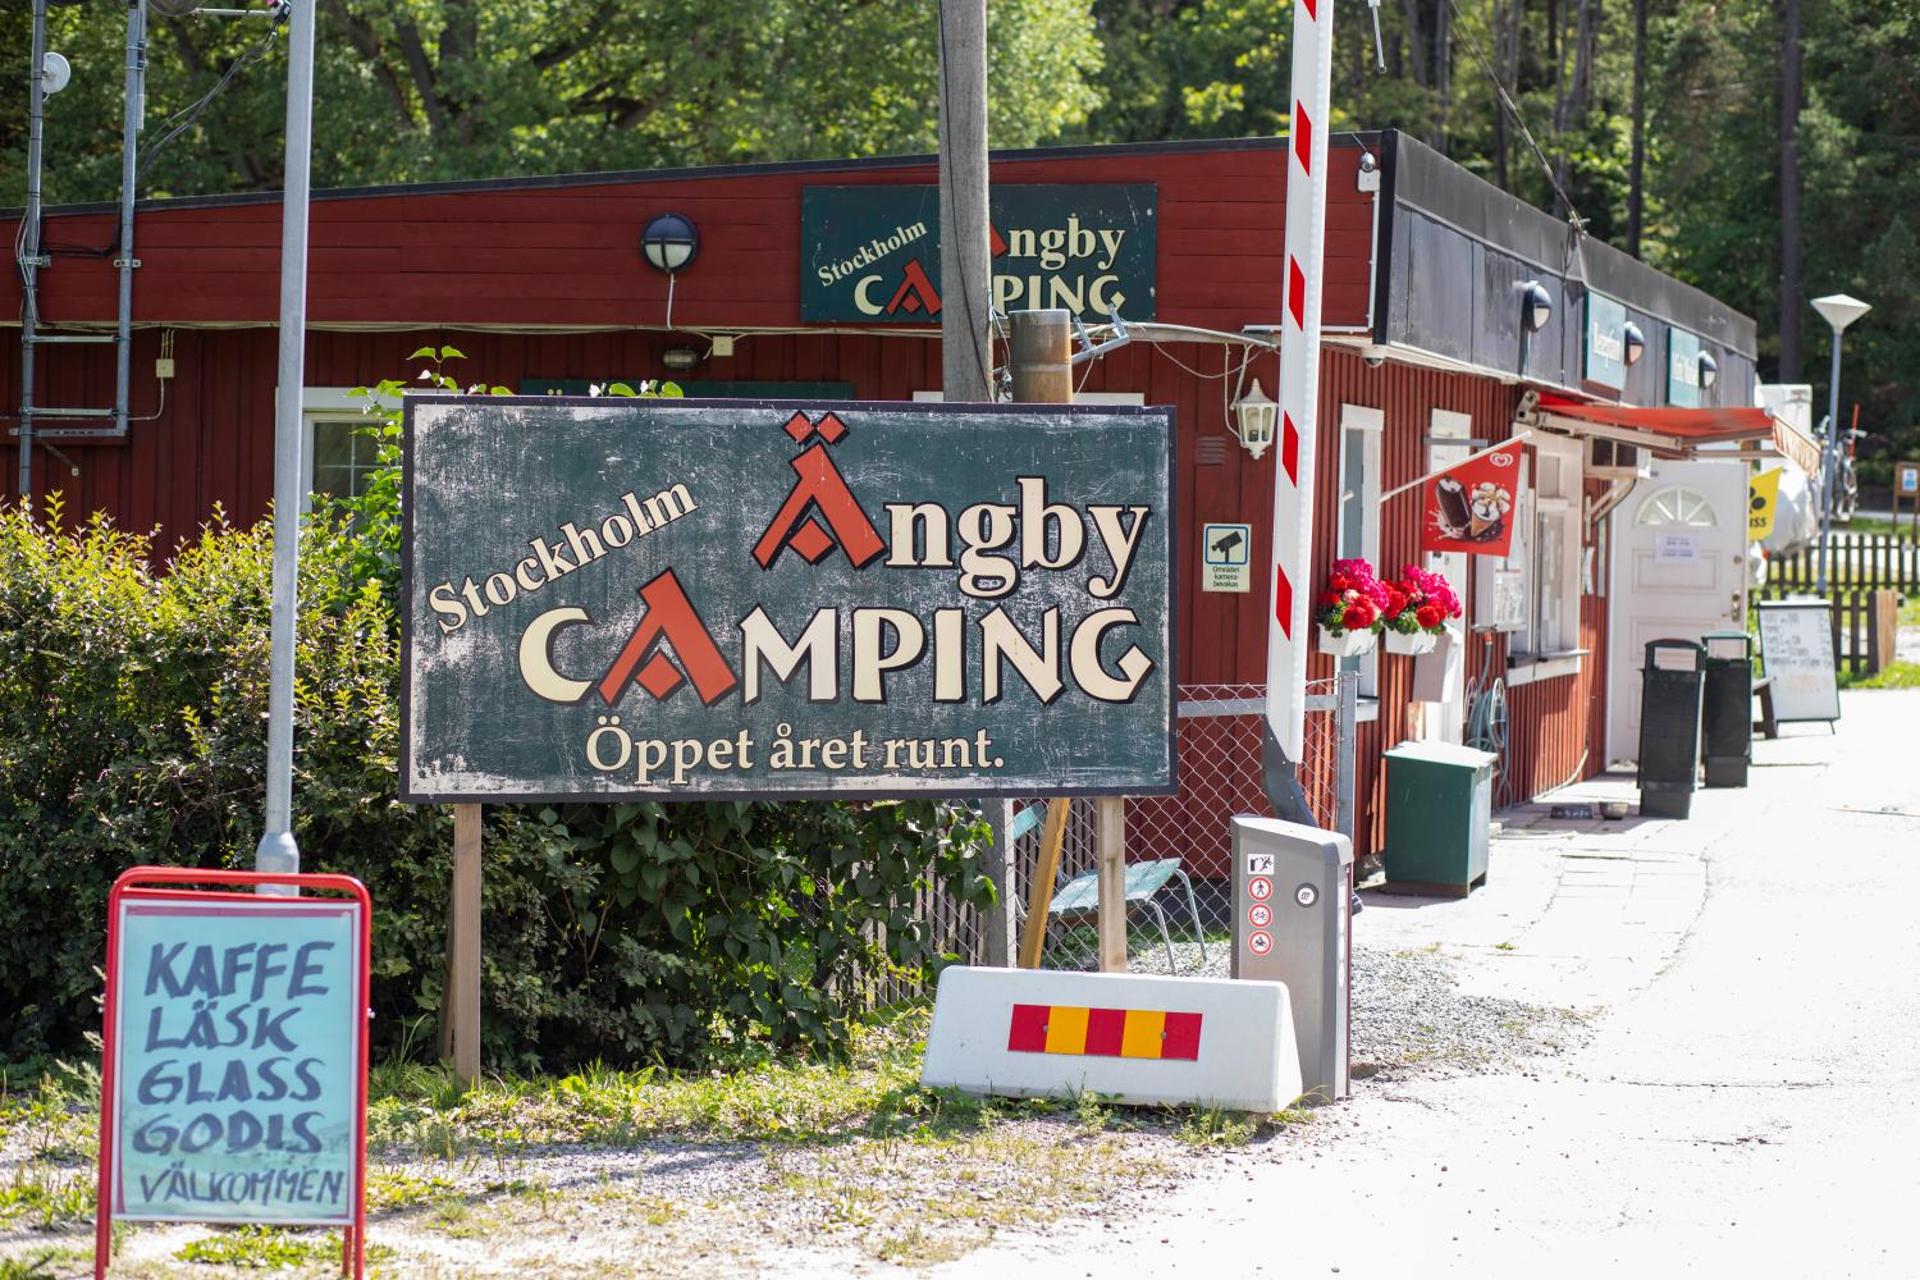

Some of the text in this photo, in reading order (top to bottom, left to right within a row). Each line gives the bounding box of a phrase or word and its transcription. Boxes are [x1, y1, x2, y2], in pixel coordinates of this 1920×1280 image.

[817, 221, 928, 287] Stockholm
[989, 216, 1126, 270] ngby
[853, 258, 1126, 316] CAPING
[752, 410, 1151, 598] Ängby
[429, 481, 699, 635] Stockholm
[518, 567, 1155, 706] CAMPING
[586, 715, 1005, 786] Öppet året runt.
[144, 941, 336, 1002] KAFFE
[144, 999, 303, 1053] LÄSK
[137, 1056, 327, 1106] GLASS
[132, 1109, 327, 1156] GODIS
[139, 1160, 345, 1206] VÄLKOMMEN
